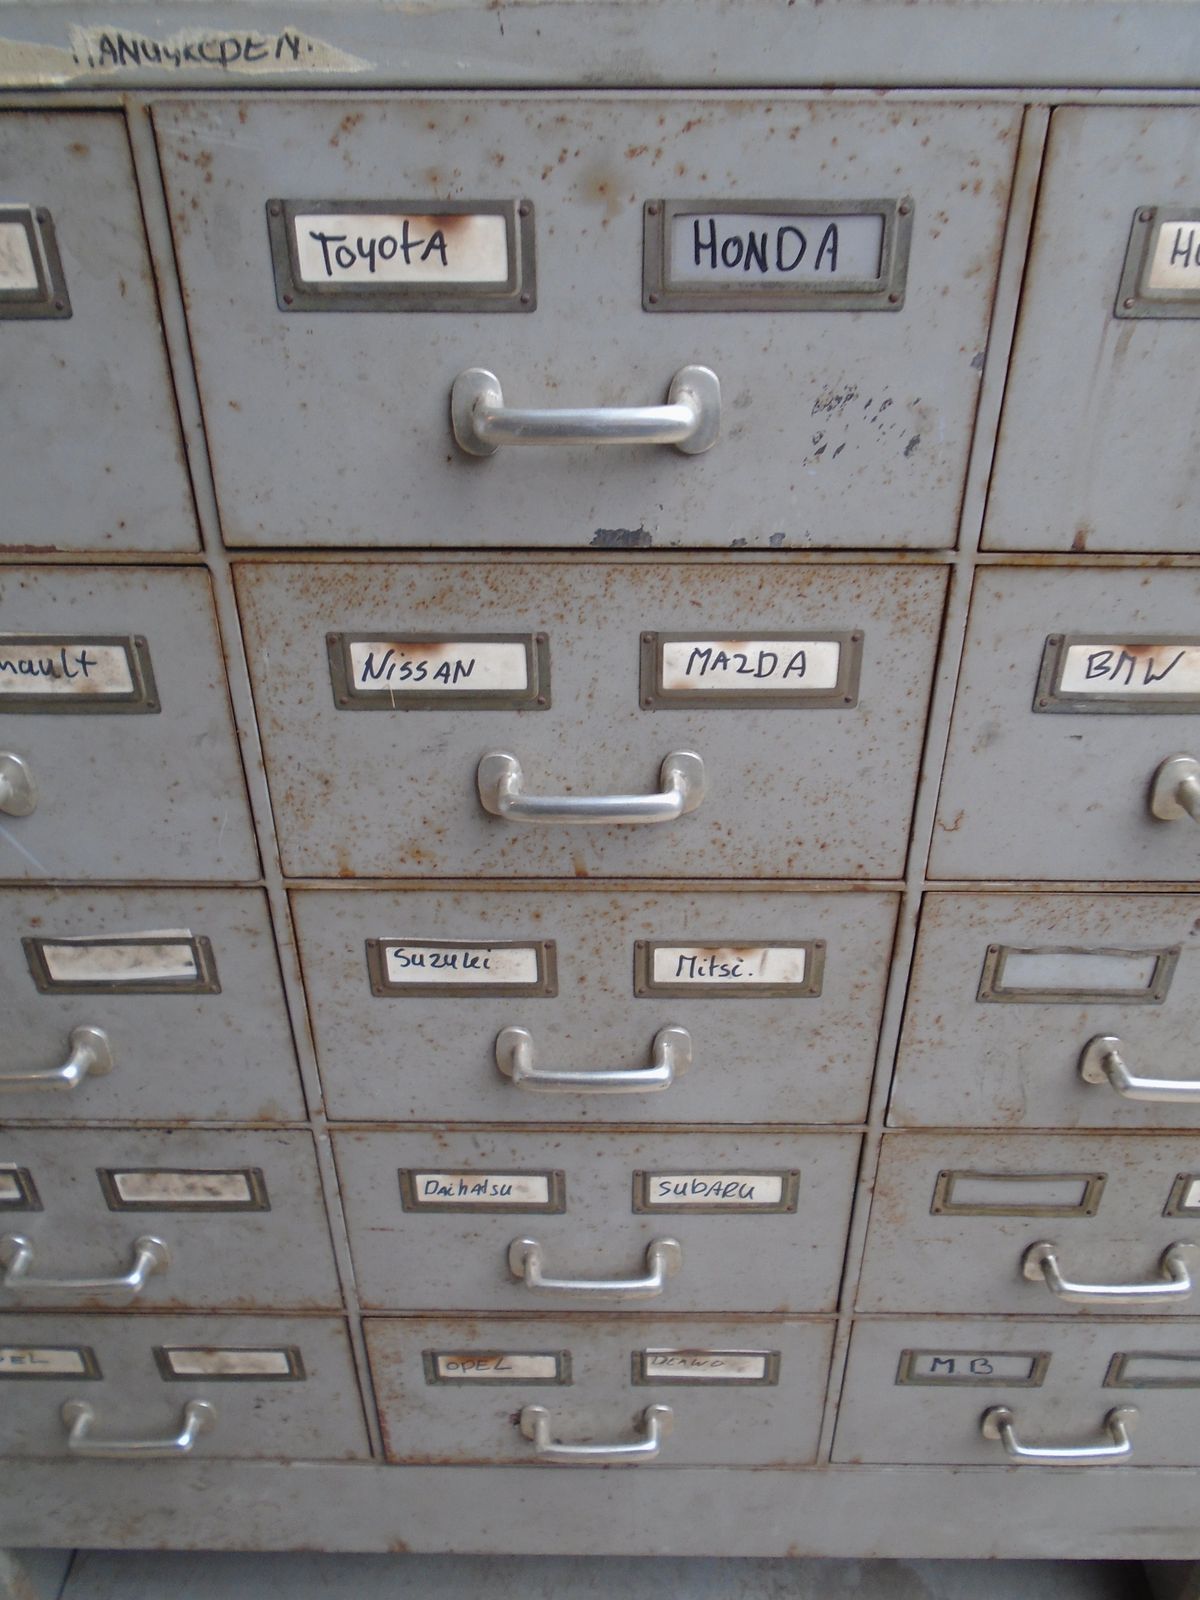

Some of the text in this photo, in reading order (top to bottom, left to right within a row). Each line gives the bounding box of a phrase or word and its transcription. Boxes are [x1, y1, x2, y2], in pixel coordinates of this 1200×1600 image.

[1085, 650, 1186, 685] BMW
[393, 947, 492, 970] Suzuki
[0, 1351, 49, 1366] EL
